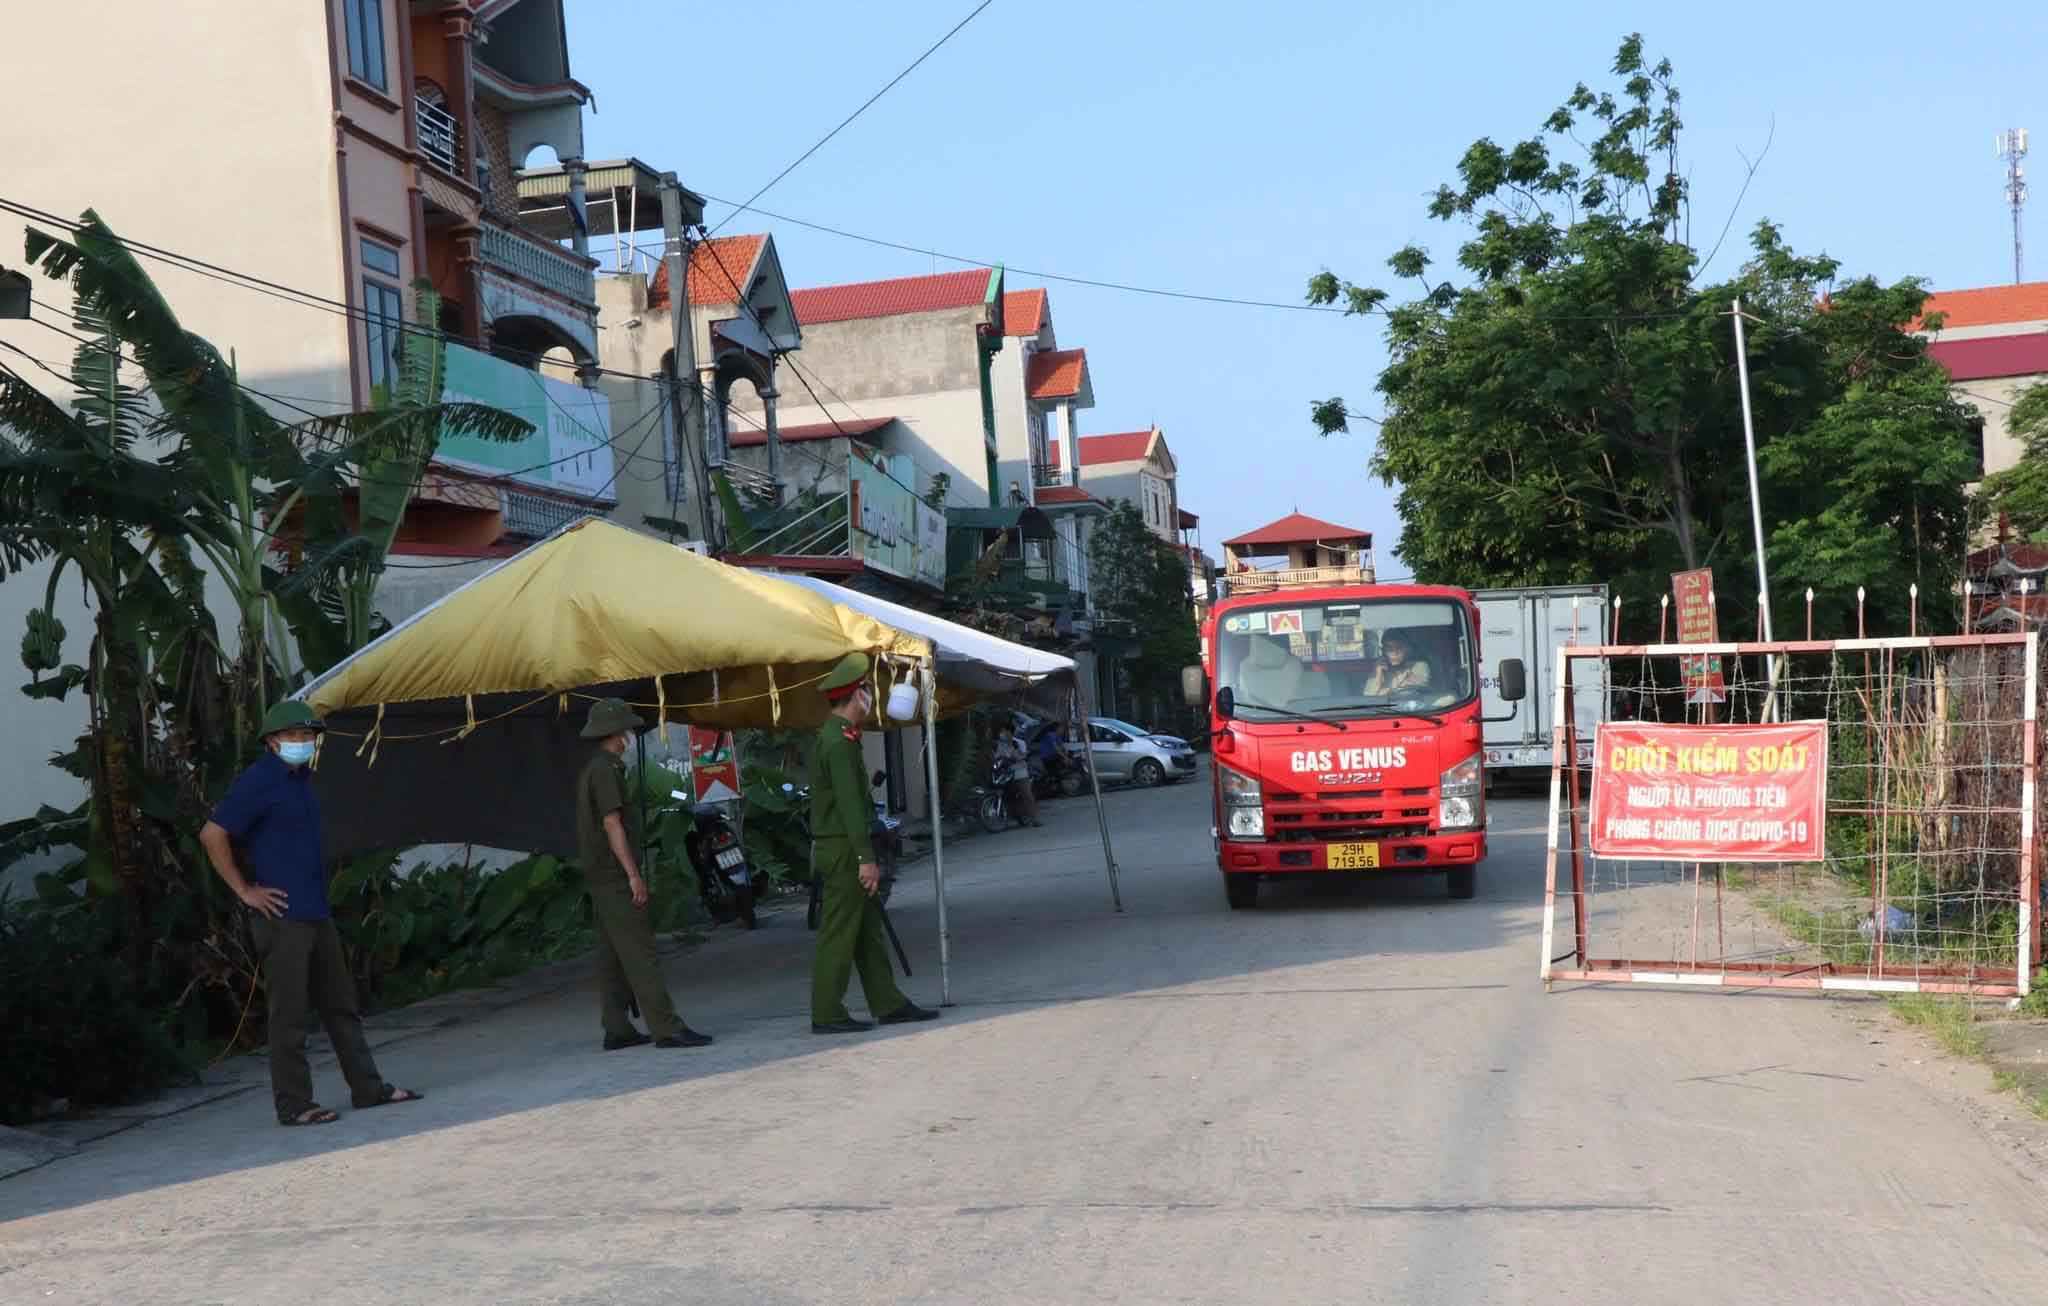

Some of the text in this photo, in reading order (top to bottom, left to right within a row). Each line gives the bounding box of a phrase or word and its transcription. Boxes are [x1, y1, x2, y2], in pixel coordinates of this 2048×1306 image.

[1291, 746, 1407, 772] GAS VENUS
[1611, 737, 1809, 772] CHỐT KIỂM SOÁT
[1318, 772, 1383, 785] ISUZU
[1673, 784, 1691, 808] VÀ
[1694, 785, 1751, 808] PHƯƠNG
[1606, 814, 1650, 841] PHÒNG
[1705, 817, 1740, 845] DỊCH
[1743, 819, 1808, 843] COVID-19
[1333, 856, 1375, 868] 719.56
[1342, 844, 1365, 856] 29H
